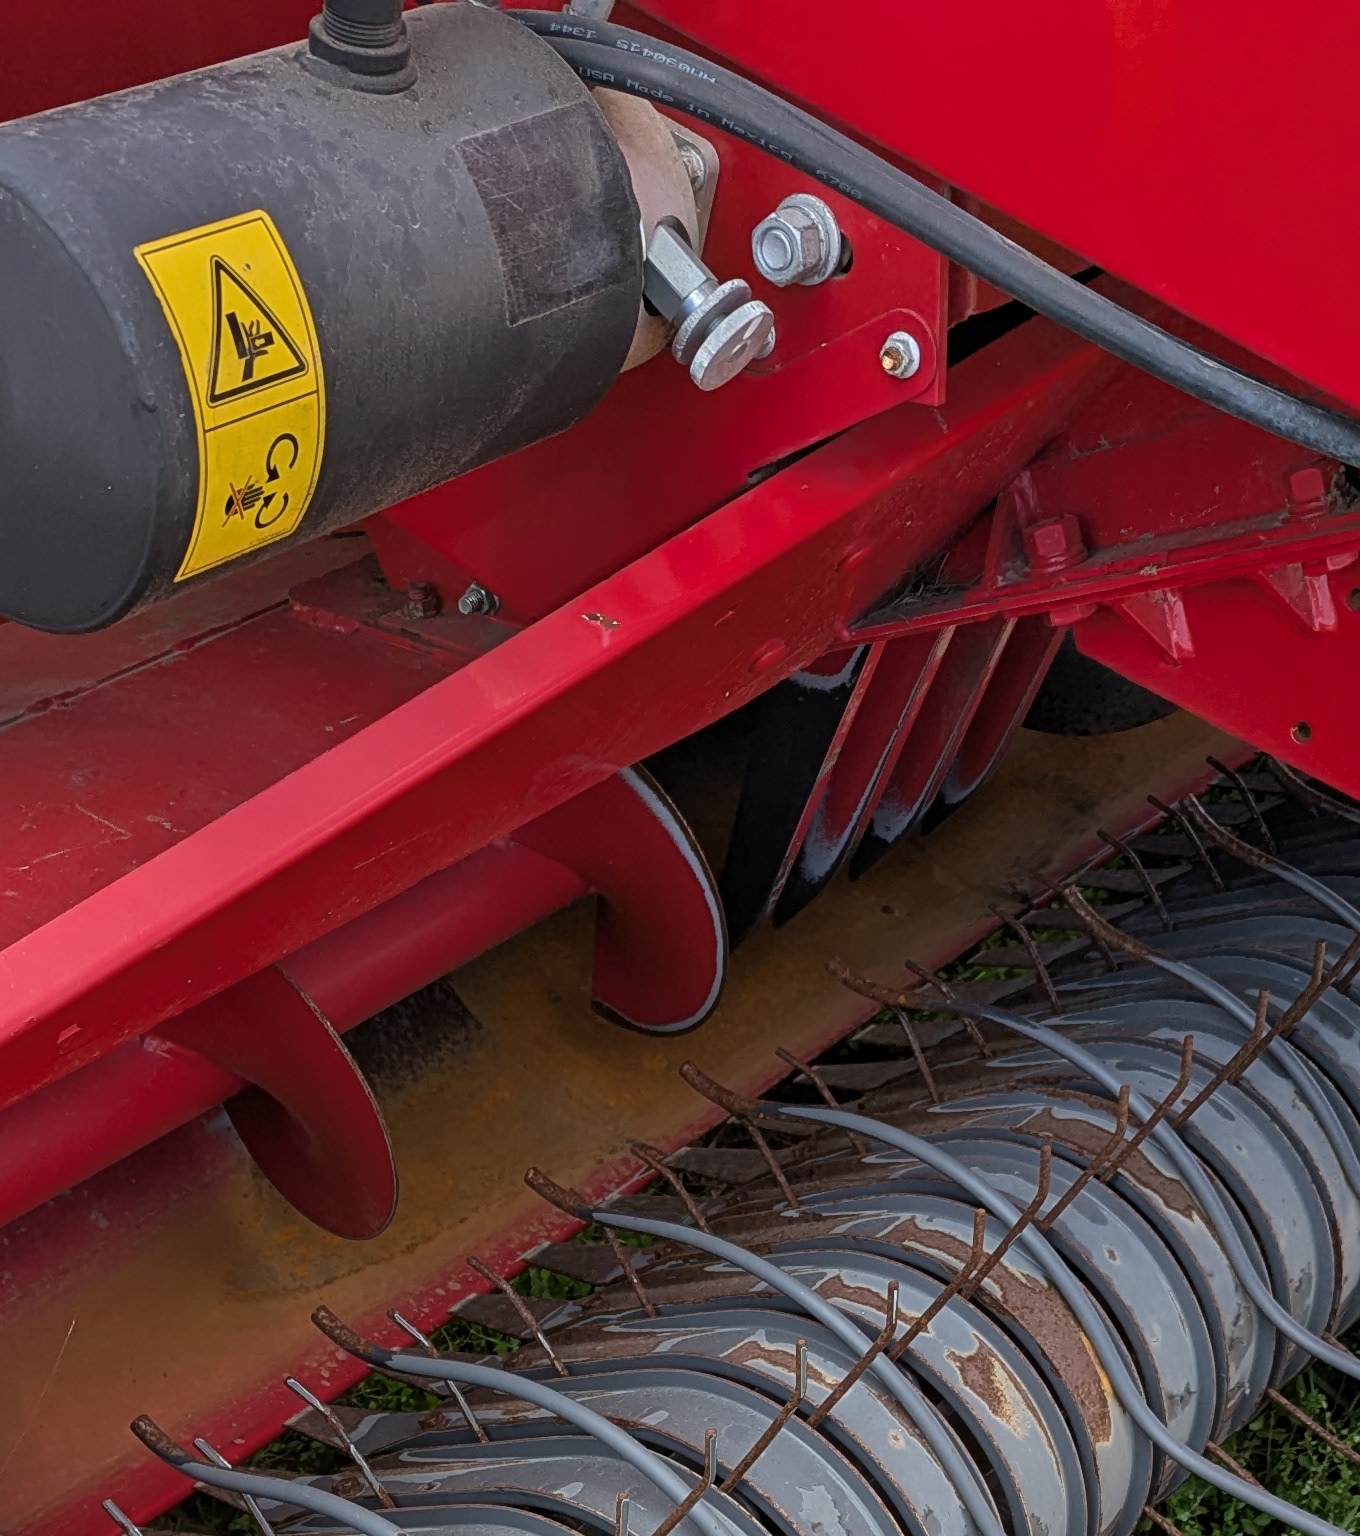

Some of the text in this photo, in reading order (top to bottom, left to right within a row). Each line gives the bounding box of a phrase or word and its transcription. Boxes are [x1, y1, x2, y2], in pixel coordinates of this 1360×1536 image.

[549, 22, 598, 39] 1344
[578, 66, 615, 83] USA
[626, 79, 674, 102] Made
[721, 117, 793, 159] Mexico
